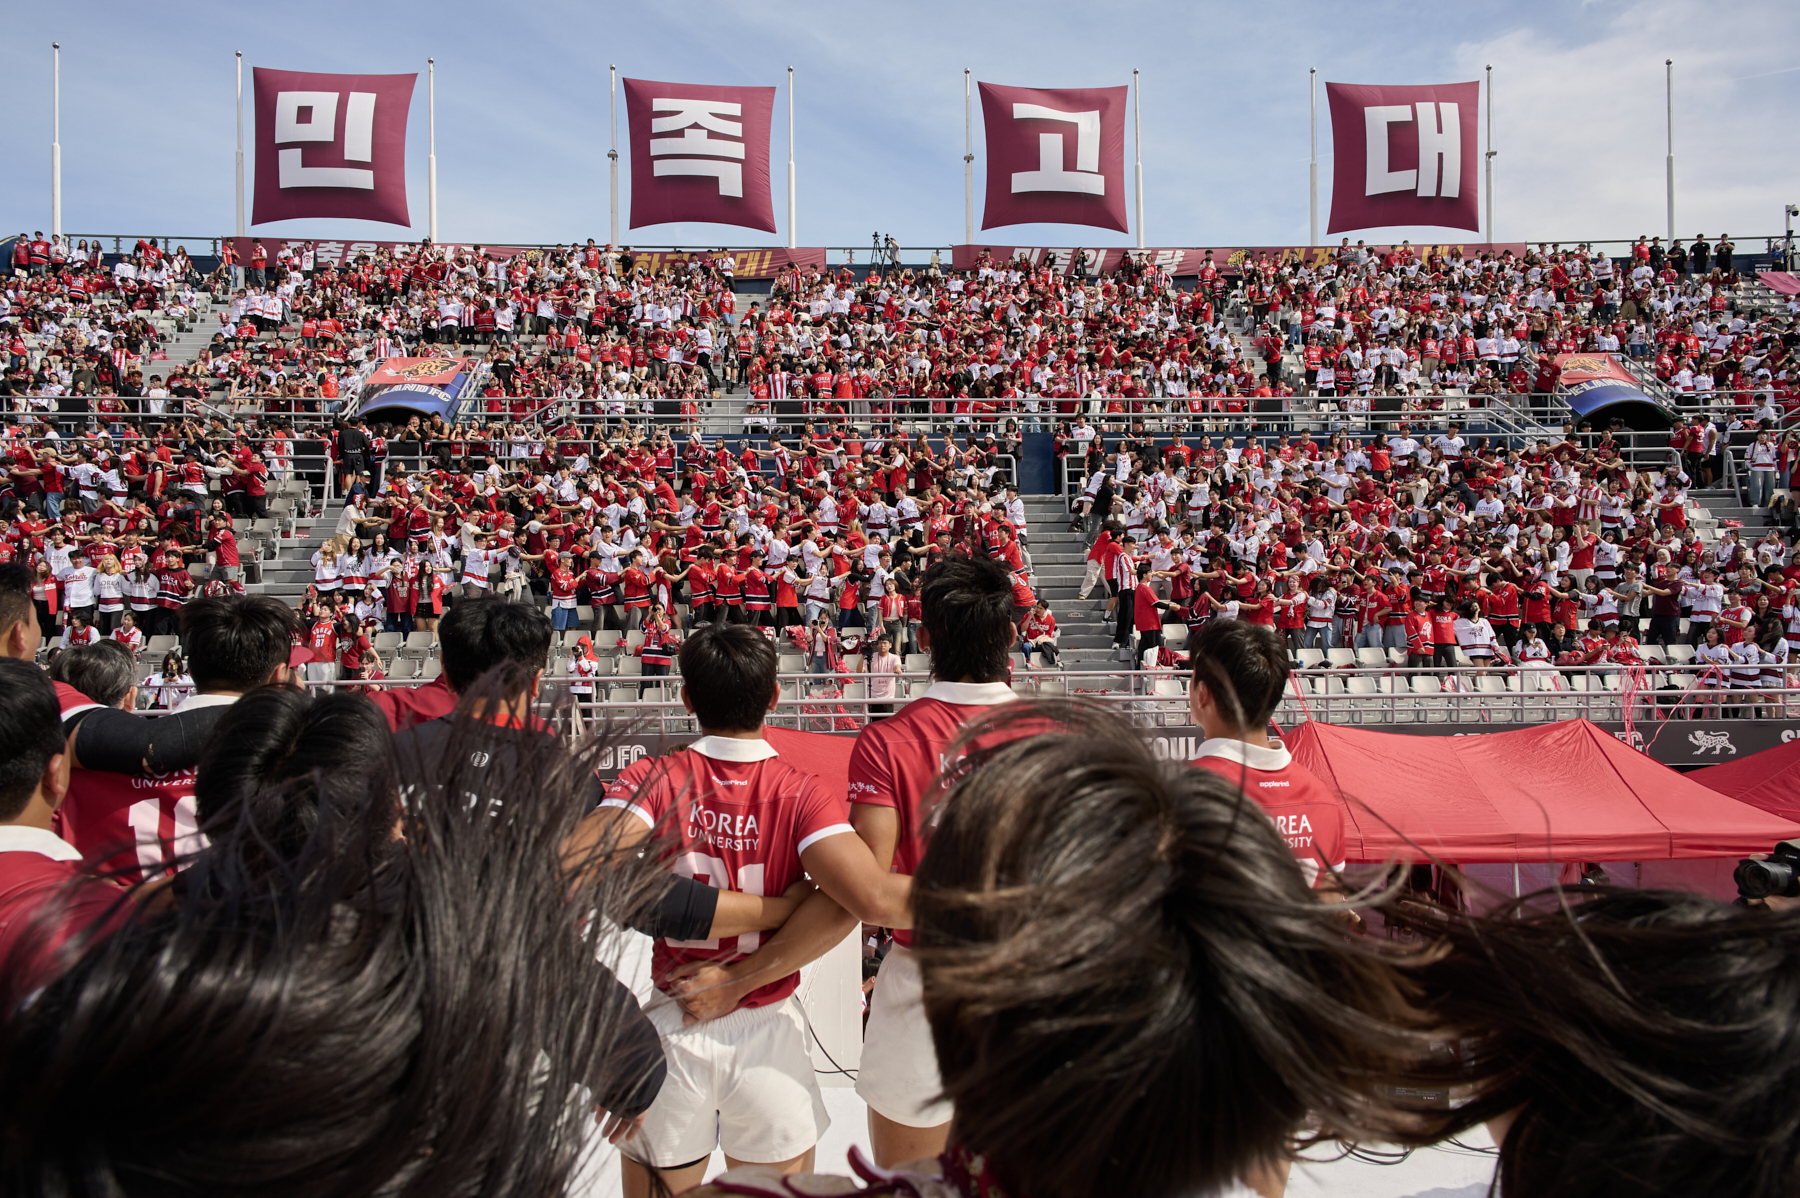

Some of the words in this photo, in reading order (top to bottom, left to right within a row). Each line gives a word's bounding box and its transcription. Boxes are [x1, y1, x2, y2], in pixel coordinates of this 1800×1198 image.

[274, 91, 377, 190] 민
[650, 98, 745, 198] 족
[1011, 103, 1105, 196] 고
[1364, 101, 1461, 198] 대
[430, 386, 452, 402] FC
[312, 627, 332, 635] KOREA
[315, 639, 324, 647] 87
[689, 803, 759, 836] KOREA
